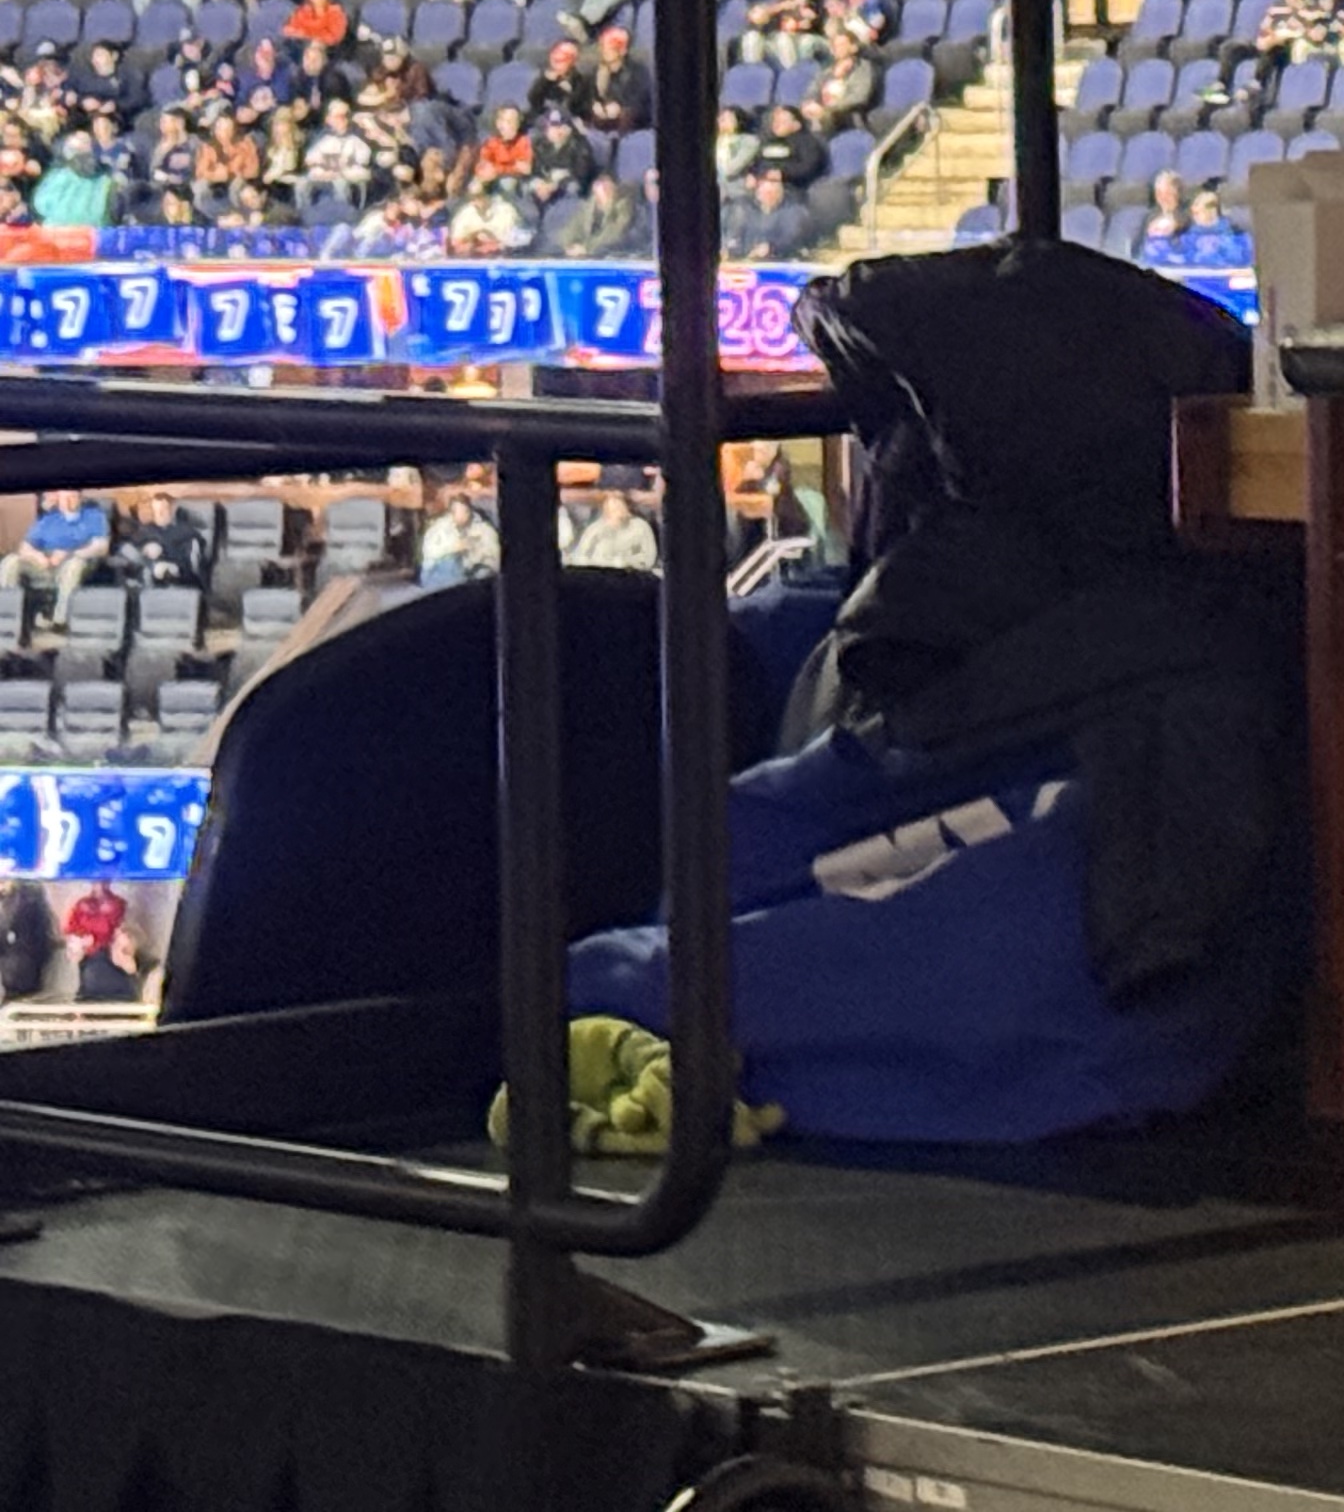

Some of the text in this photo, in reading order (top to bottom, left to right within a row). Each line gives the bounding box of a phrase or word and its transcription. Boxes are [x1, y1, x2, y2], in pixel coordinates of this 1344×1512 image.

[52, 288, 90, 339] 7
[120, 277, 158, 329] 7
[210, 288, 250, 342] 7
[319, 298, 359, 348] 7
[442, 280, 481, 331] 7
[595, 287, 630, 338] 7
[138, 816, 177, 869] 7
